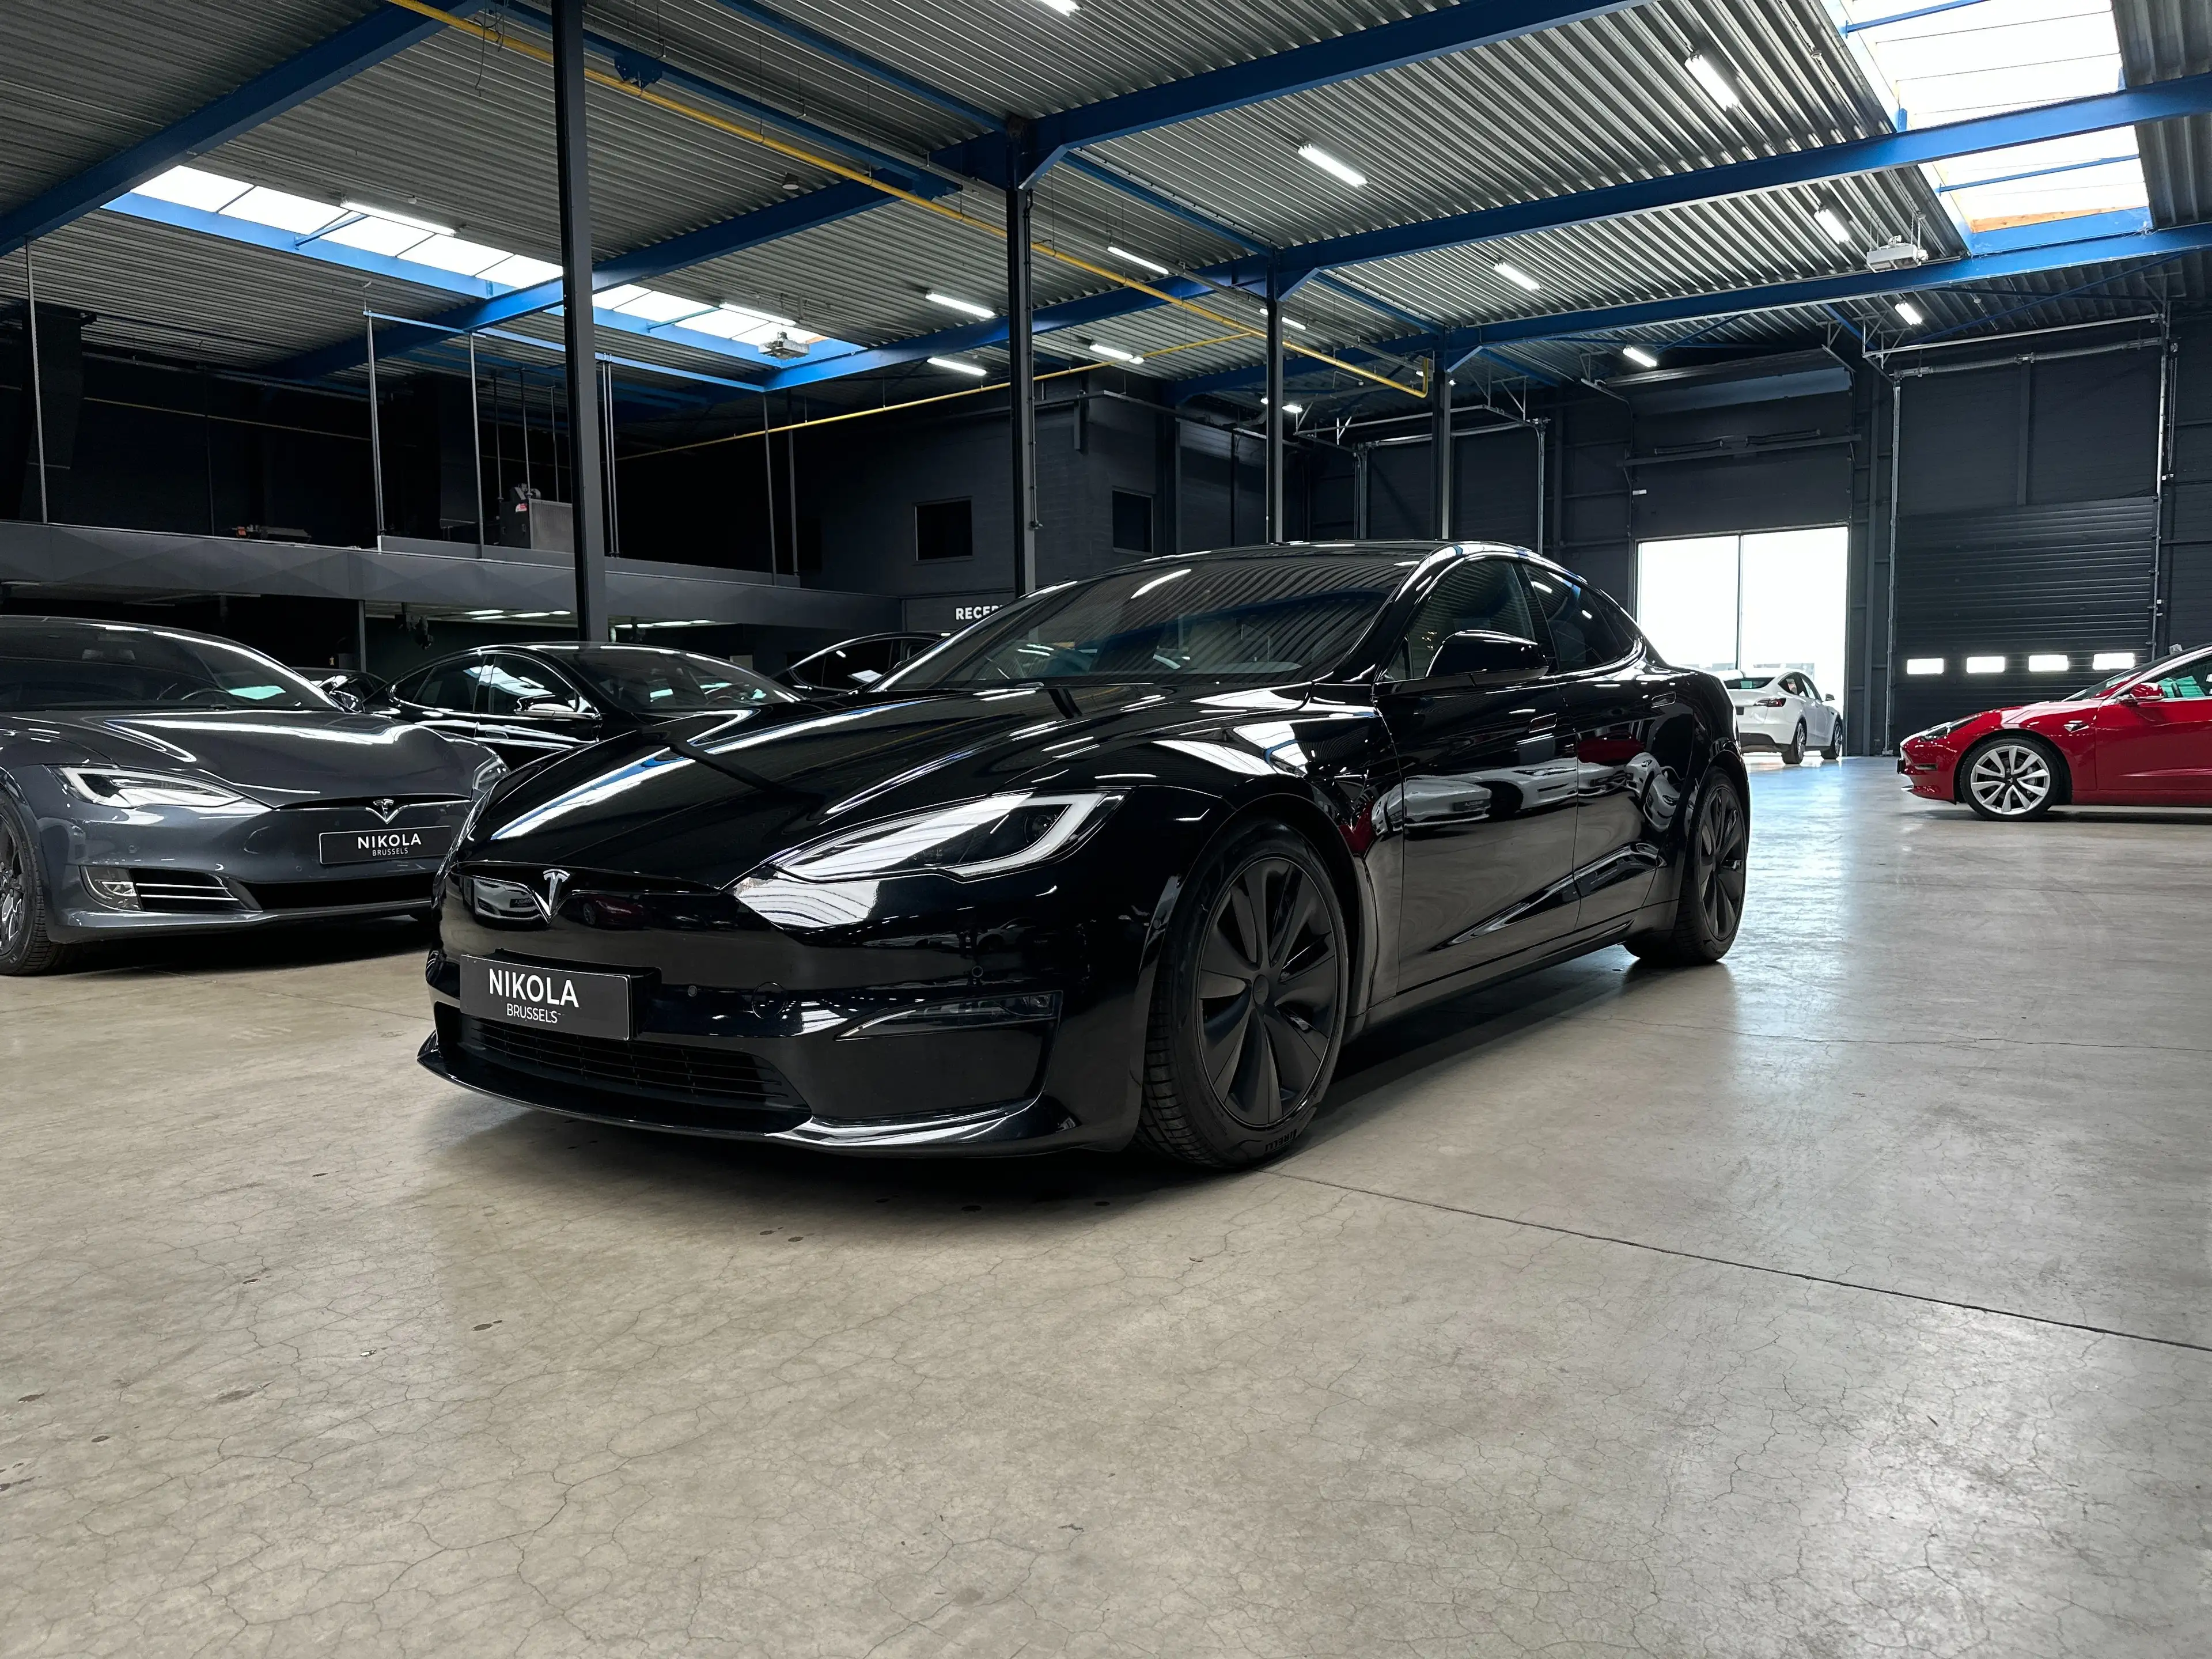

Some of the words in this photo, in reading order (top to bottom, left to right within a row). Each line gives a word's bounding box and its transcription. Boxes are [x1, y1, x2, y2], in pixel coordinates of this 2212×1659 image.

[357, 833, 422, 849] NIKOLA
[372, 847, 408, 857] BRUSSELS
[489, 968, 579, 1008] NIKOLA
[506, 1003, 558, 1024] BRUSSELS
